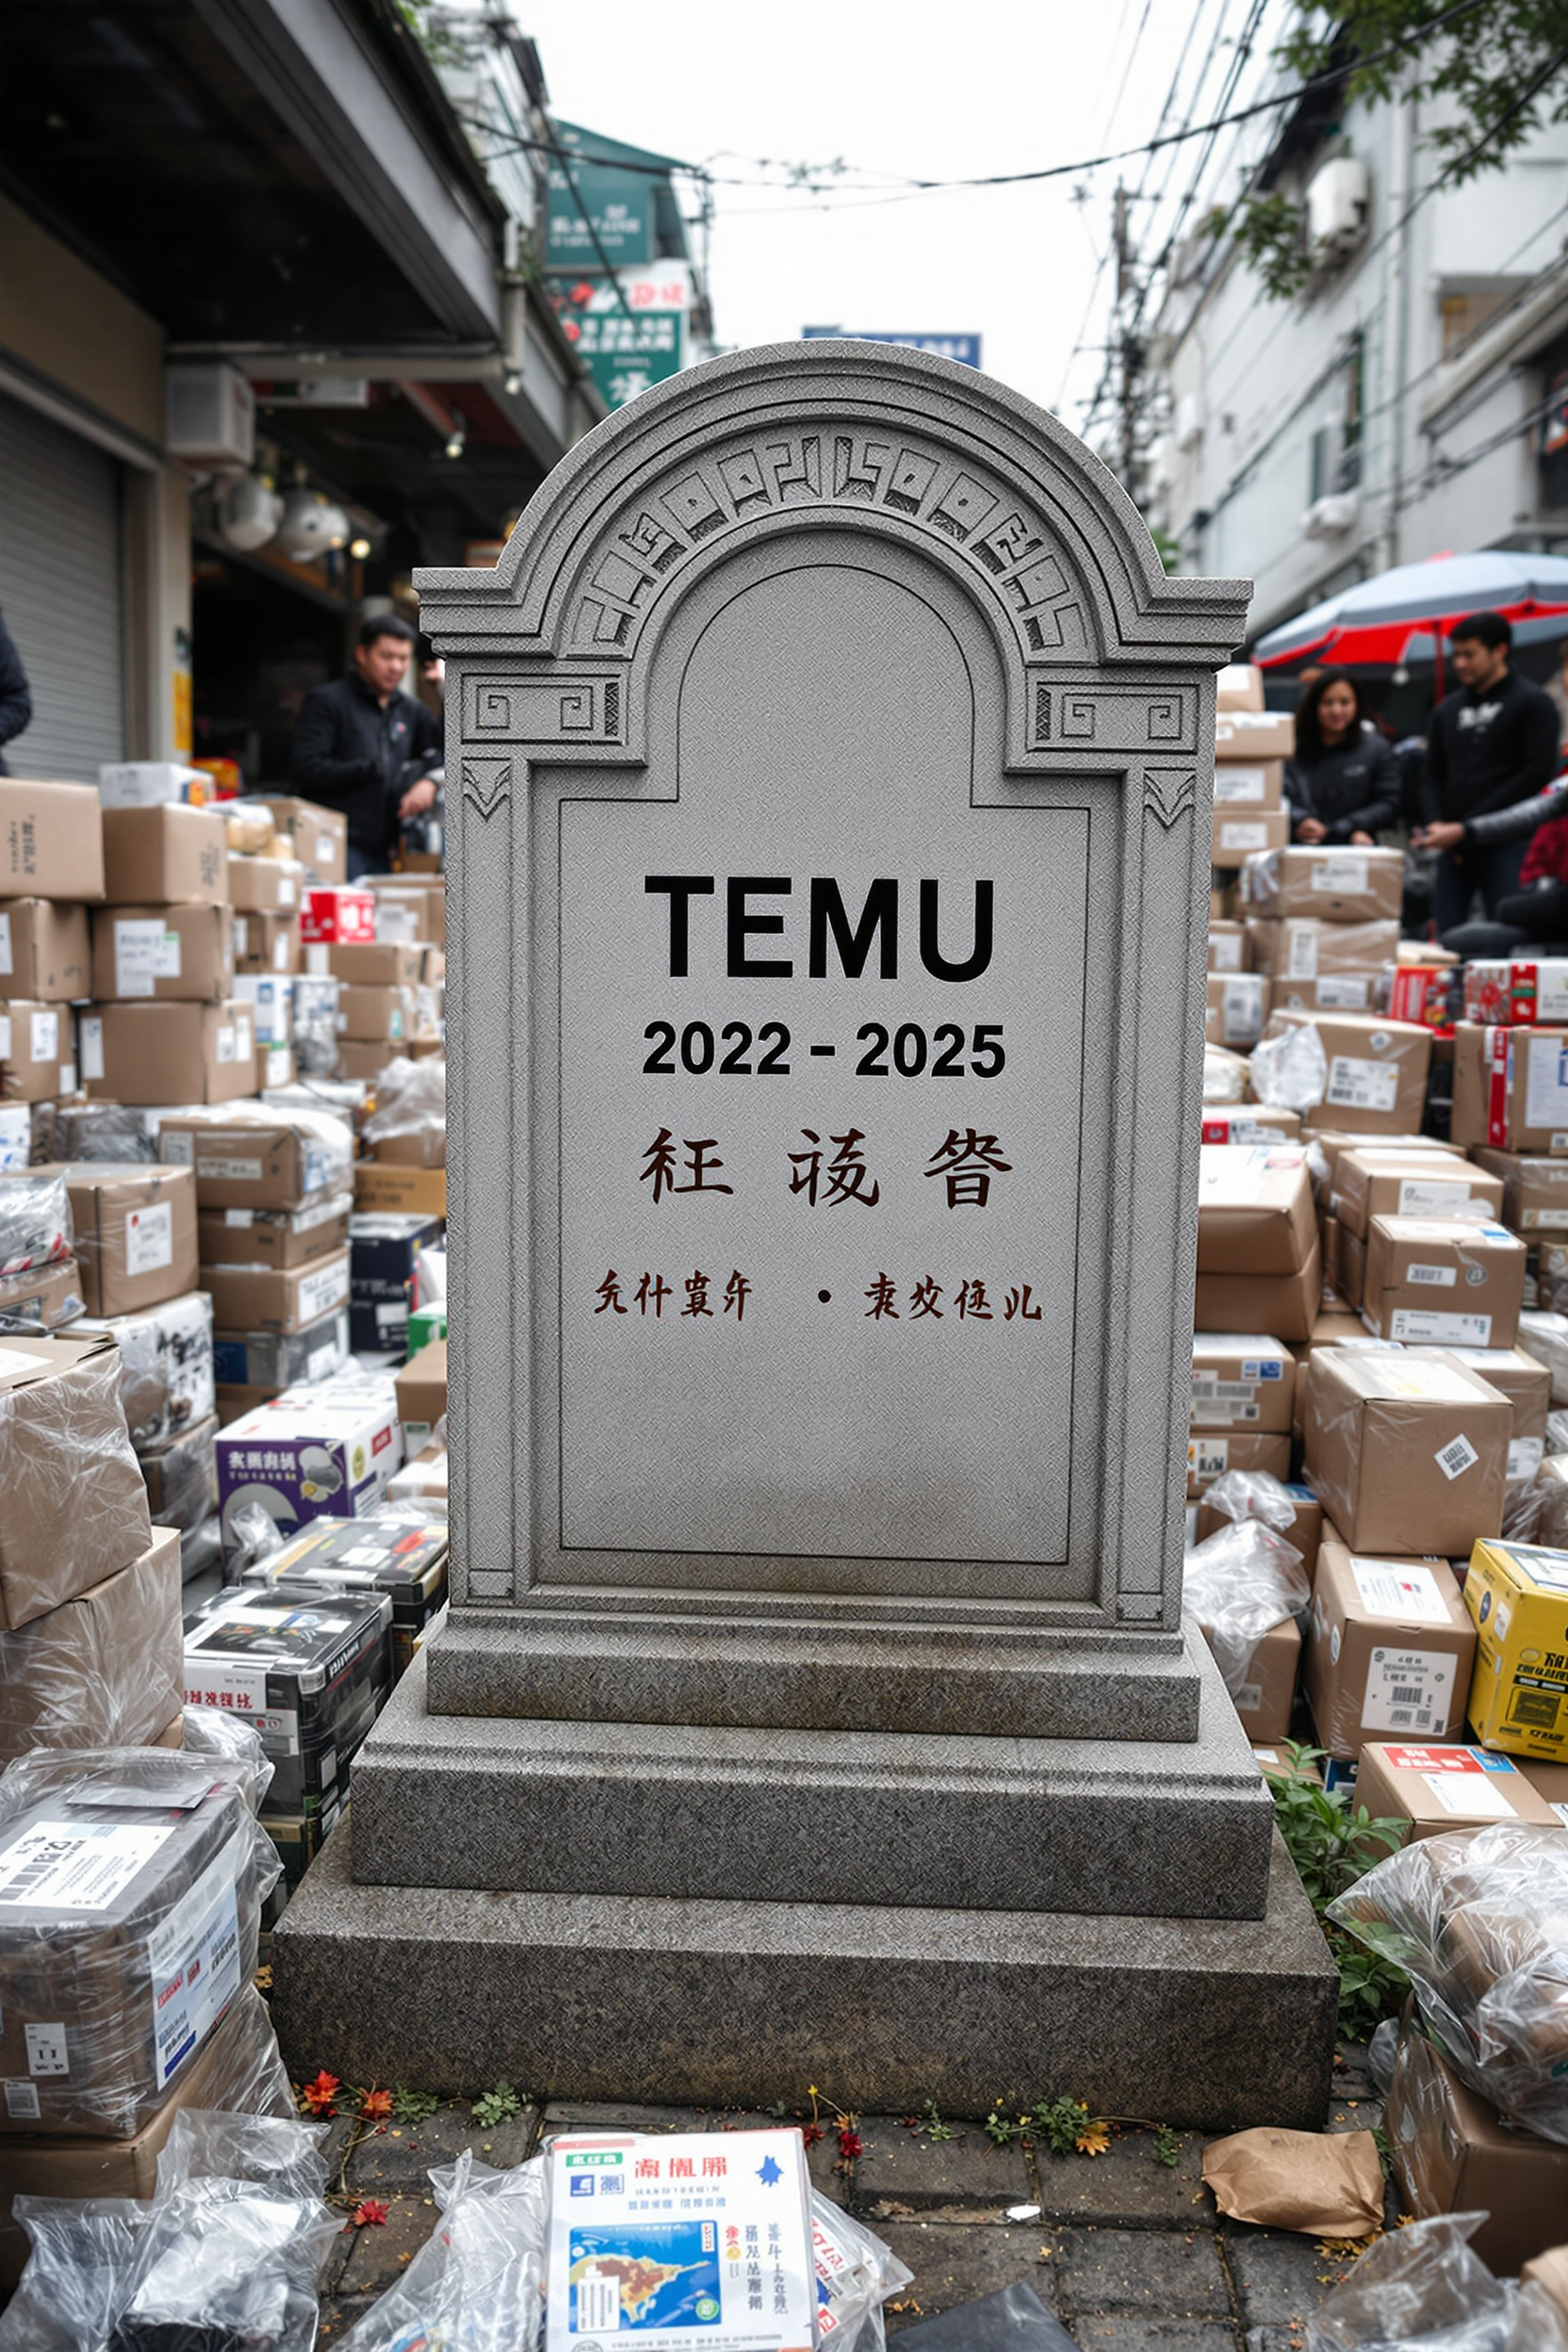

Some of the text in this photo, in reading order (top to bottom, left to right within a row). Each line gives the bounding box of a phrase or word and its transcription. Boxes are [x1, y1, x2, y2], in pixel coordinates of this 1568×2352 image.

[645, 875, 993, 983] TEMU
[643, 1021, 792, 1075] 2022
[855, 1022, 1005, 1079] 2025
